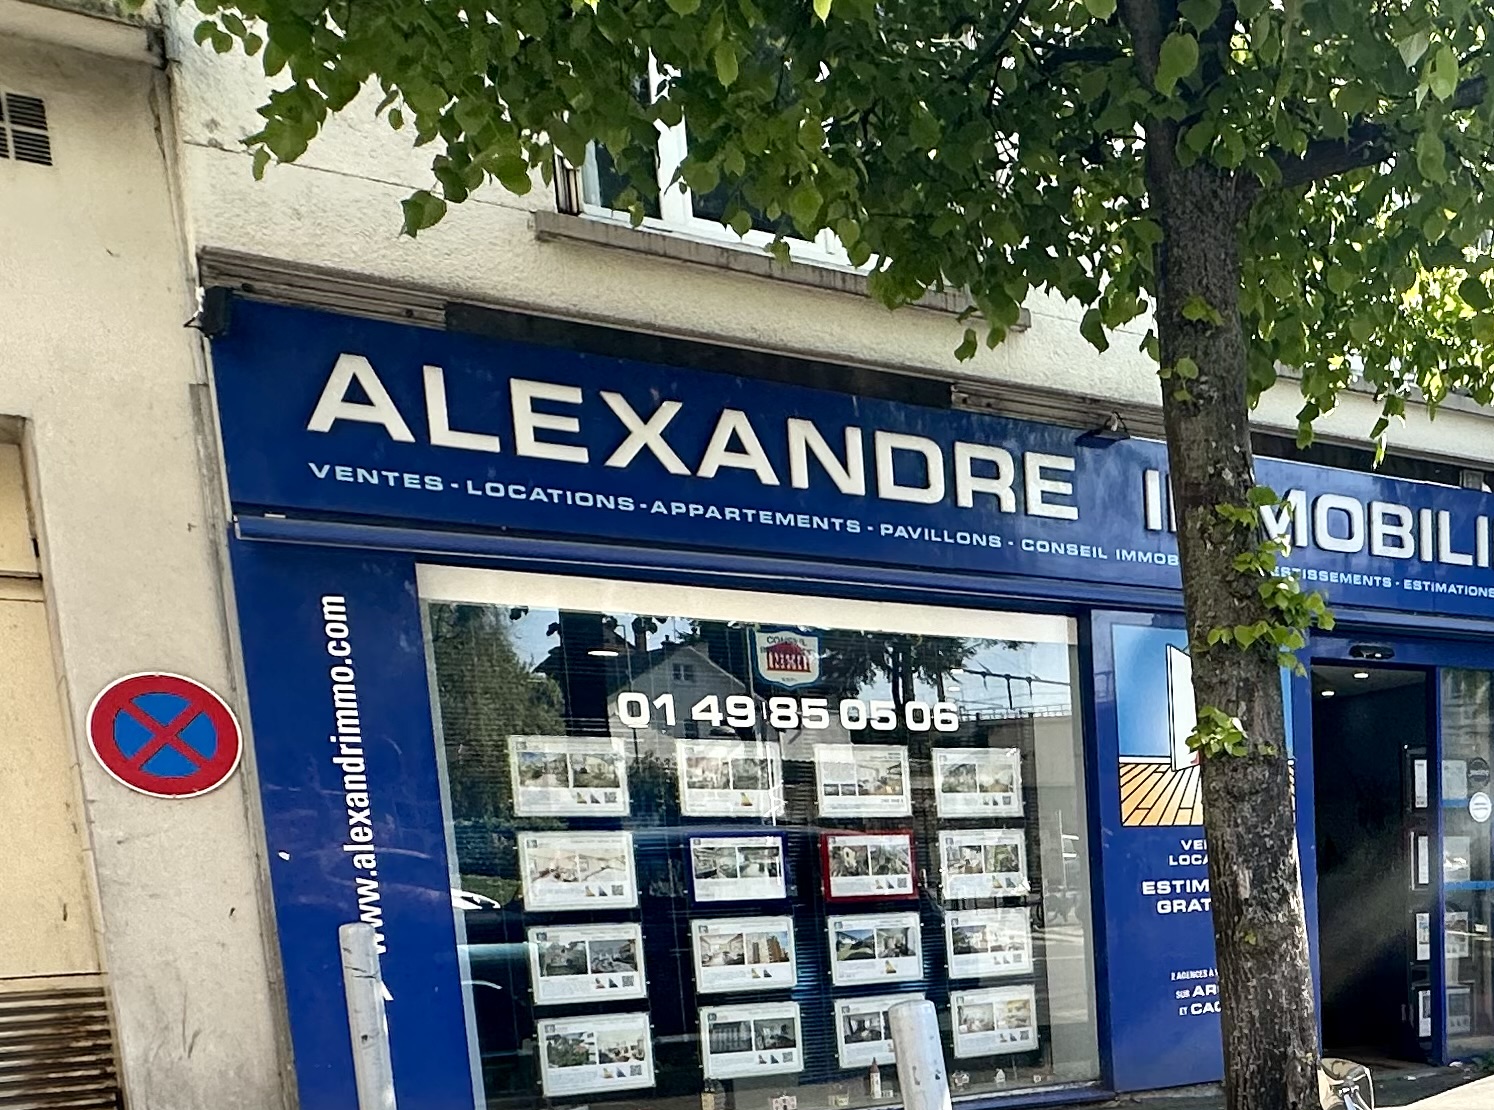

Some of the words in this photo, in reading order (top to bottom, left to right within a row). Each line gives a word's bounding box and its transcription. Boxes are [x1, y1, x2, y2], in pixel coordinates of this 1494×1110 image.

[306, 352, 1079, 520] ALEXANDRE
[308, 462, 443, 491] VENTES
[467, 479, 635, 512] LOCATIONS
[651, 500, 861, 533] APPARTEMENTS
[880, 523, 1001, 548] PAVILLONS
[1021, 538, 1108, 560] CONSEIL
[617, 692, 676, 729] 01
[691, 695, 755, 728] 49
[768, 697, 830, 730] 85
[839, 699, 897, 731] 05
[905, 701, 960, 732] 06
[322, 594, 386, 955] ww.alexandrimmo.com
[1192, 983, 1220, 997] AR
